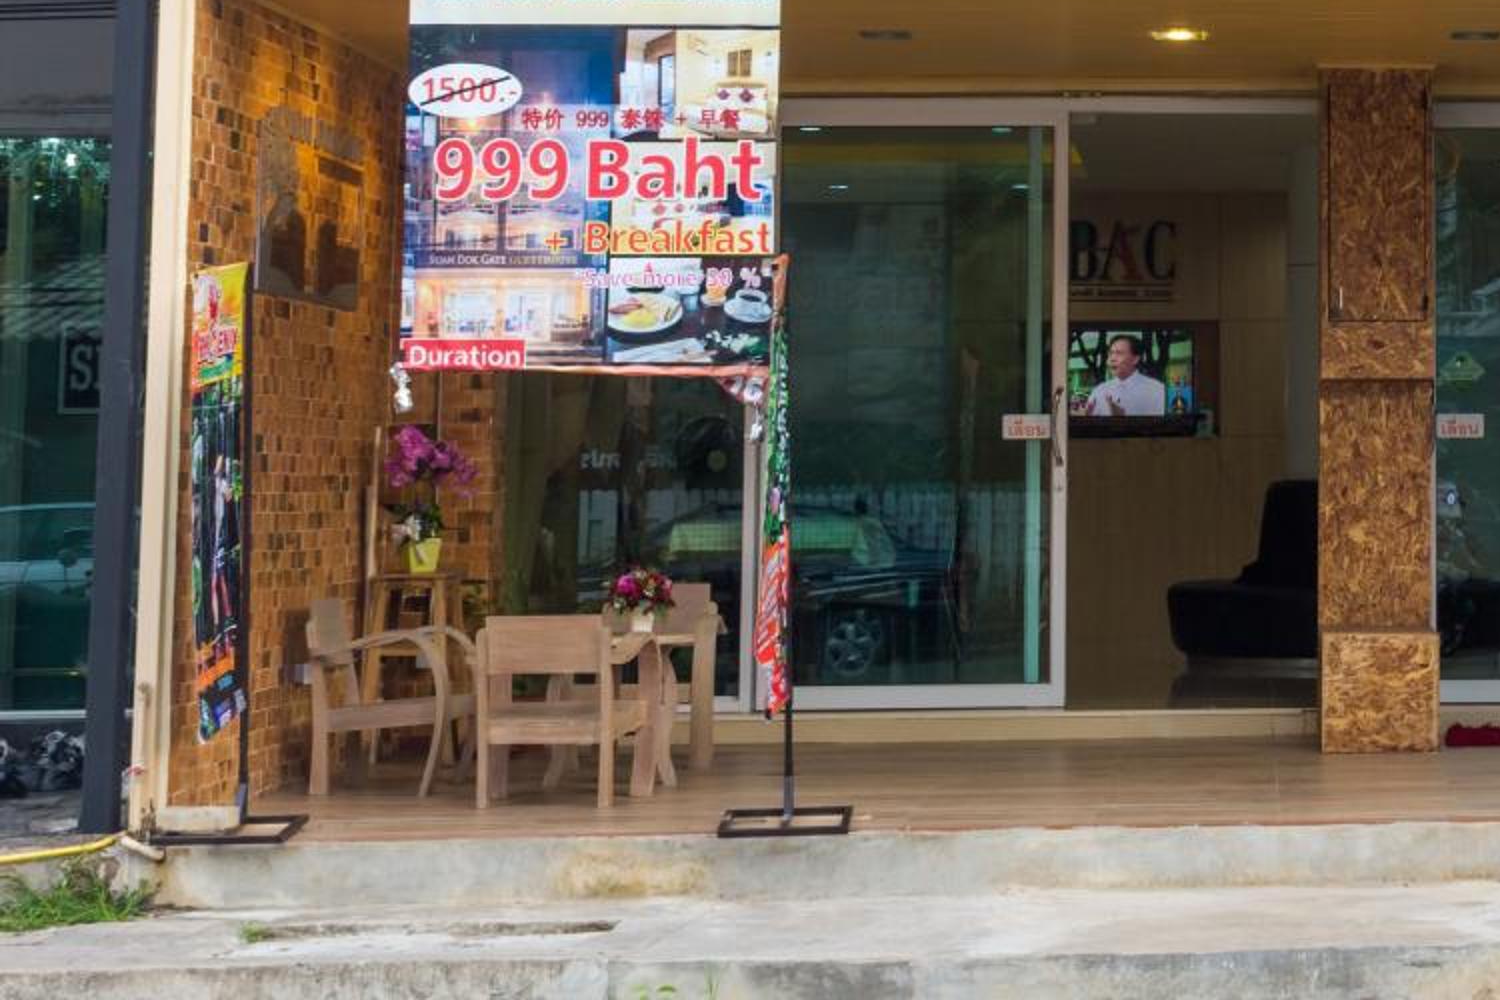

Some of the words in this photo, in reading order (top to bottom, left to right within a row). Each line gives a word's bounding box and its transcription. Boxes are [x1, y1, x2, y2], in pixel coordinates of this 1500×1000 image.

[575, 109, 610, 128] 999
[435, 138, 569, 201] 999
[587, 137, 763, 200] Baht
[545, 232, 566, 251] +
[585, 220, 771, 254] Breakfast
[409, 344, 521, 370] Duration
